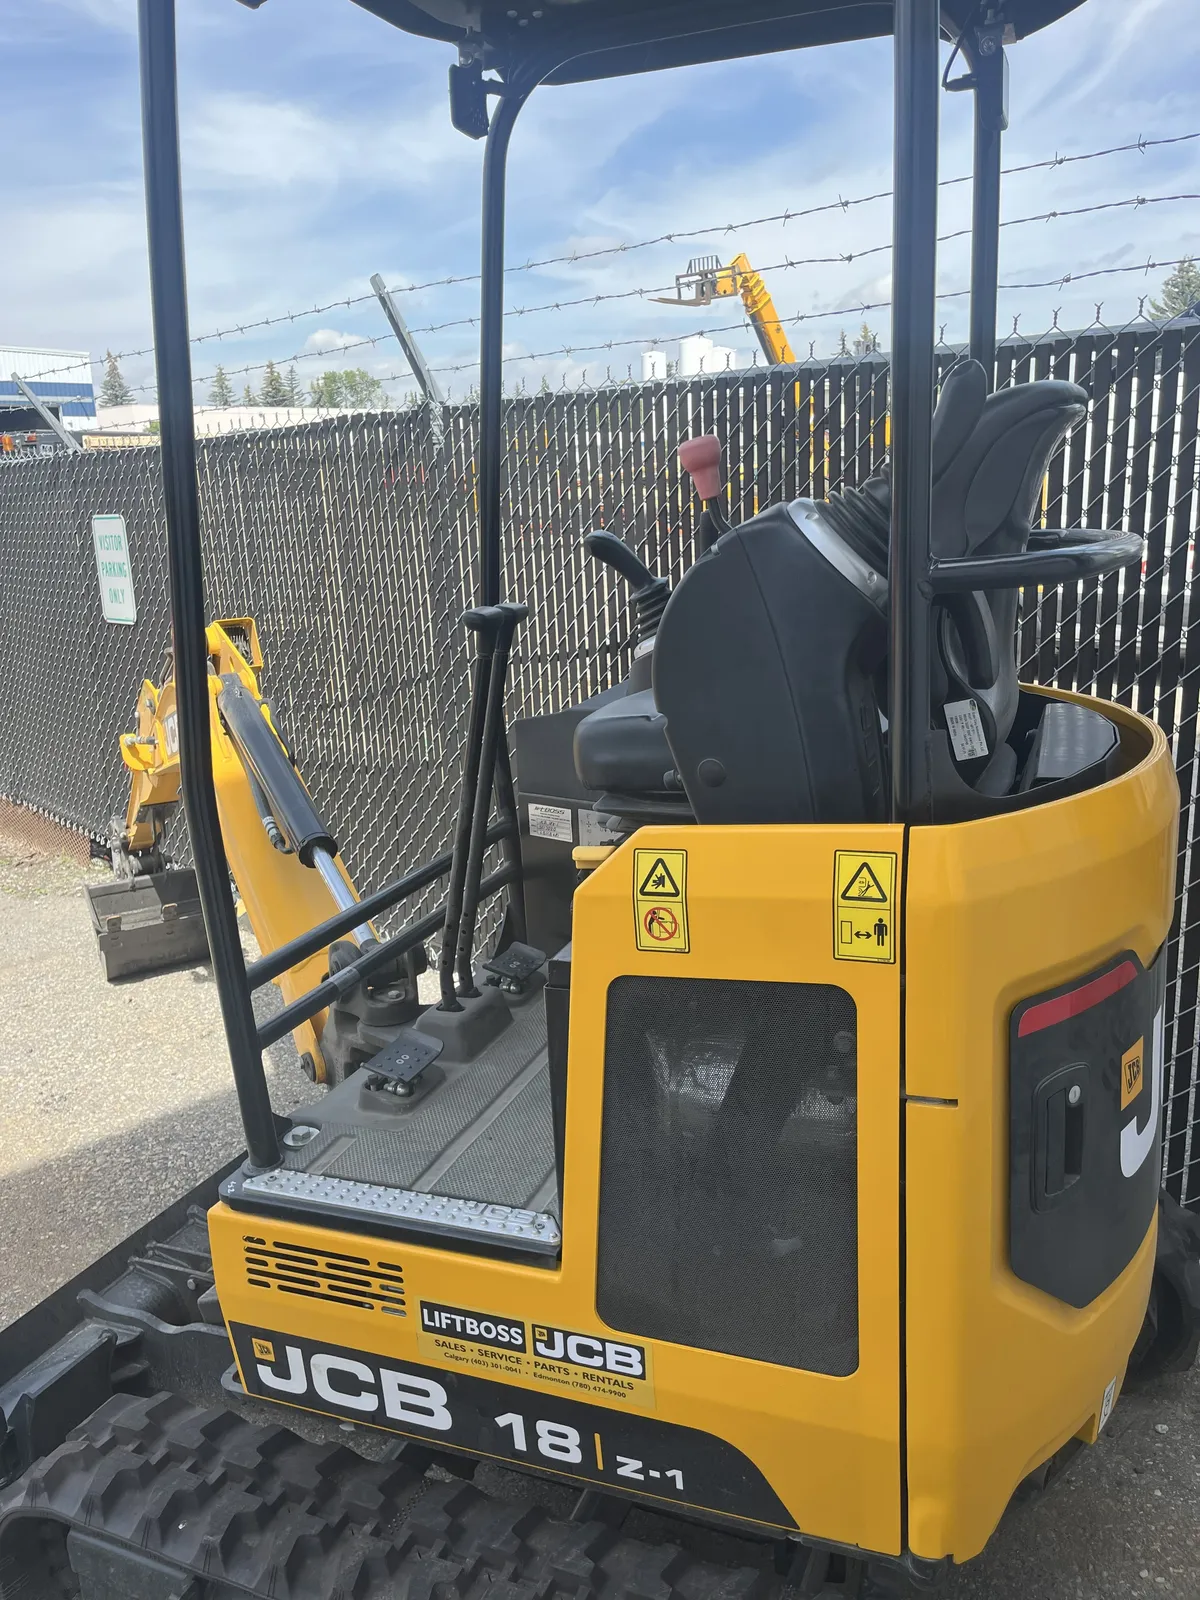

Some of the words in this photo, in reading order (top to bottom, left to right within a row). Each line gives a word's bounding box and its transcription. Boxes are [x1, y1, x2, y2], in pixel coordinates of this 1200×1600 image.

[98, 535, 122, 551] VISITOR
[101, 561, 127, 577] PARKING
[108, 588, 125, 604] ONLY
[1127, 1058, 1141, 1089] JCB
[463, 1200, 538, 1227] JCB
[422, 1308, 523, 1345] LIFTBOSS
[434, 1339, 467, 1352] SALES
[477, 1348, 522, 1365] SERVICE
[534, 1361, 570, 1376] PARTS
[582, 1371, 634, 1390] RENTALS
[536, 1331, 643, 1376] JCB
[256, 1345, 453, 1431] JCB
[444, 1352, 469, 1363] Calgary
[471, 1357, 489, 1368] (403)
[491, 1362, 521, 1374] 301-0041
[533, 1371, 570, 1385] Edmonton
[572, 1381, 591, 1391] (780)
[592, 1386, 627, 1398] 474-9900
[494, 1412, 582, 1464] 18
